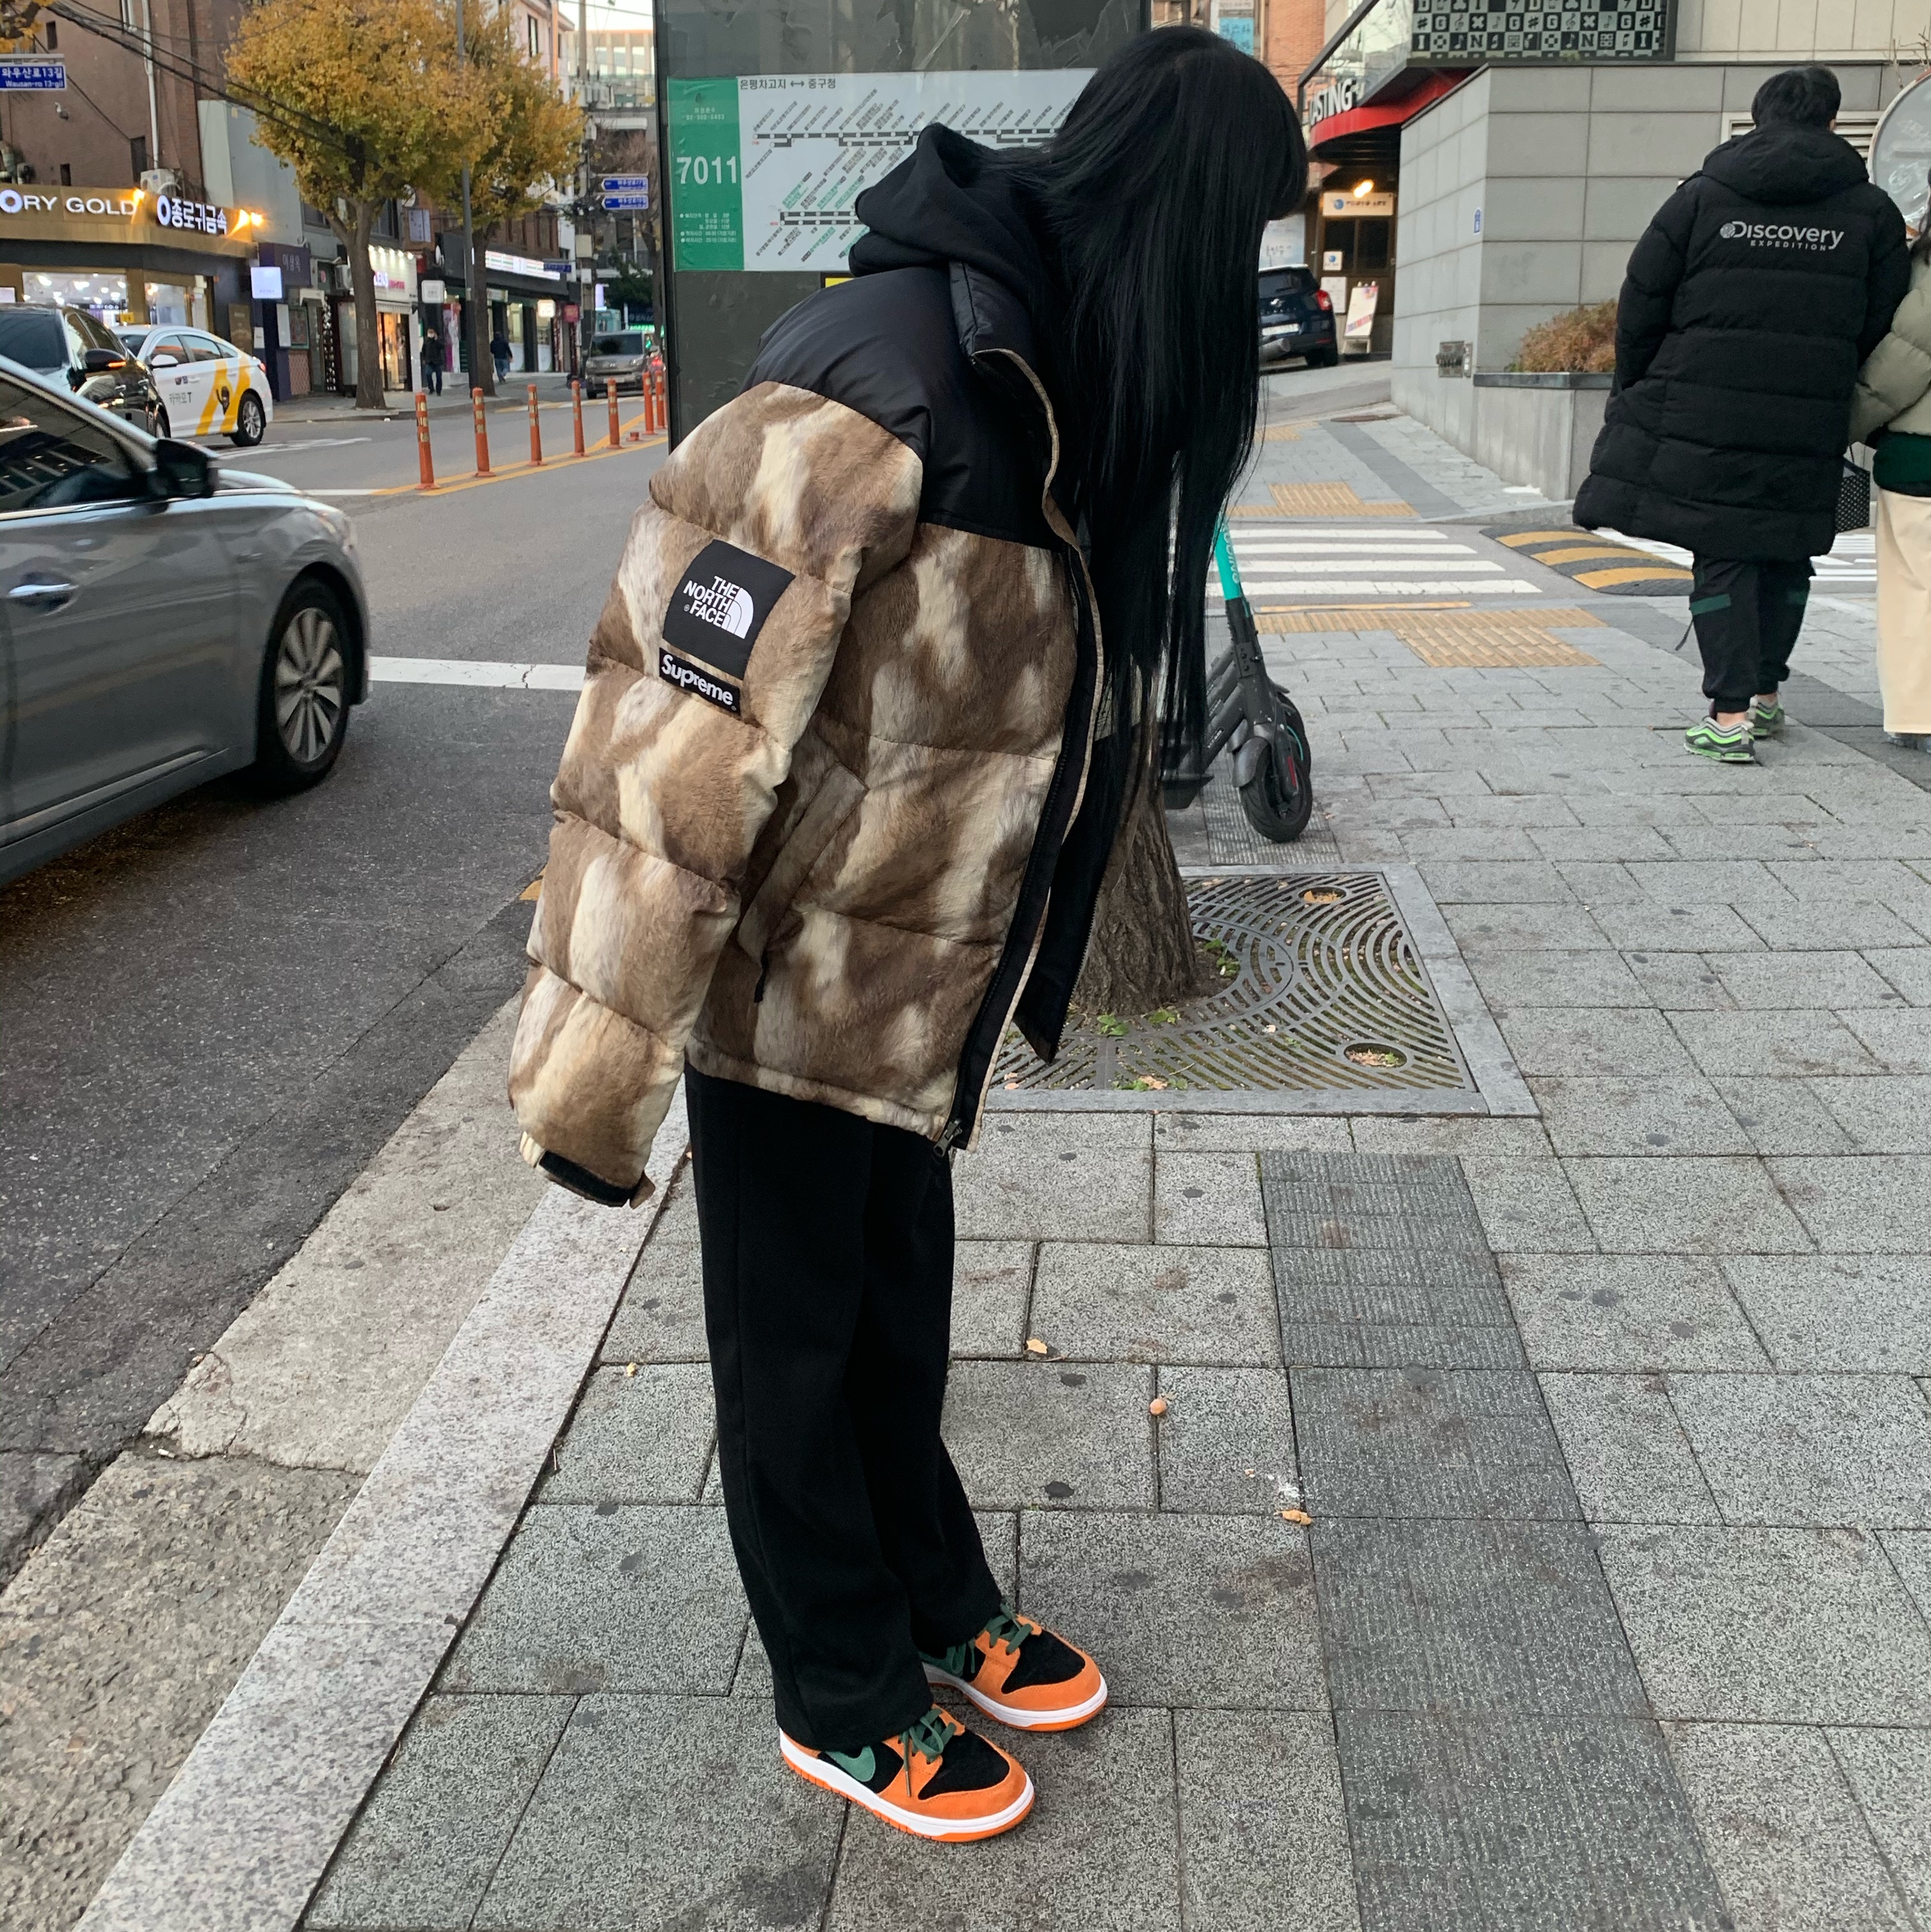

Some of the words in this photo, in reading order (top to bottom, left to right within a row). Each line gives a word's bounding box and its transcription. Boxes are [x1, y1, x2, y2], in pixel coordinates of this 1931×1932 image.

[1, 66, 63, 79] 와우산로13길
[44, 80, 63, 88] 13-gil
[740, 79, 786, 90] 은평차고지
[808, 78, 836, 89] 중구청
[676, 156, 737, 185] 7011
[66, 197, 137, 215] GOLD
[1750, 240, 1826, 251] EXPEDITION
[683, 580, 732, 613] NORTH
[711, 575, 740, 600] THE
[690, 599, 727, 628] FACE
[661, 654, 734, 706] Supreme
